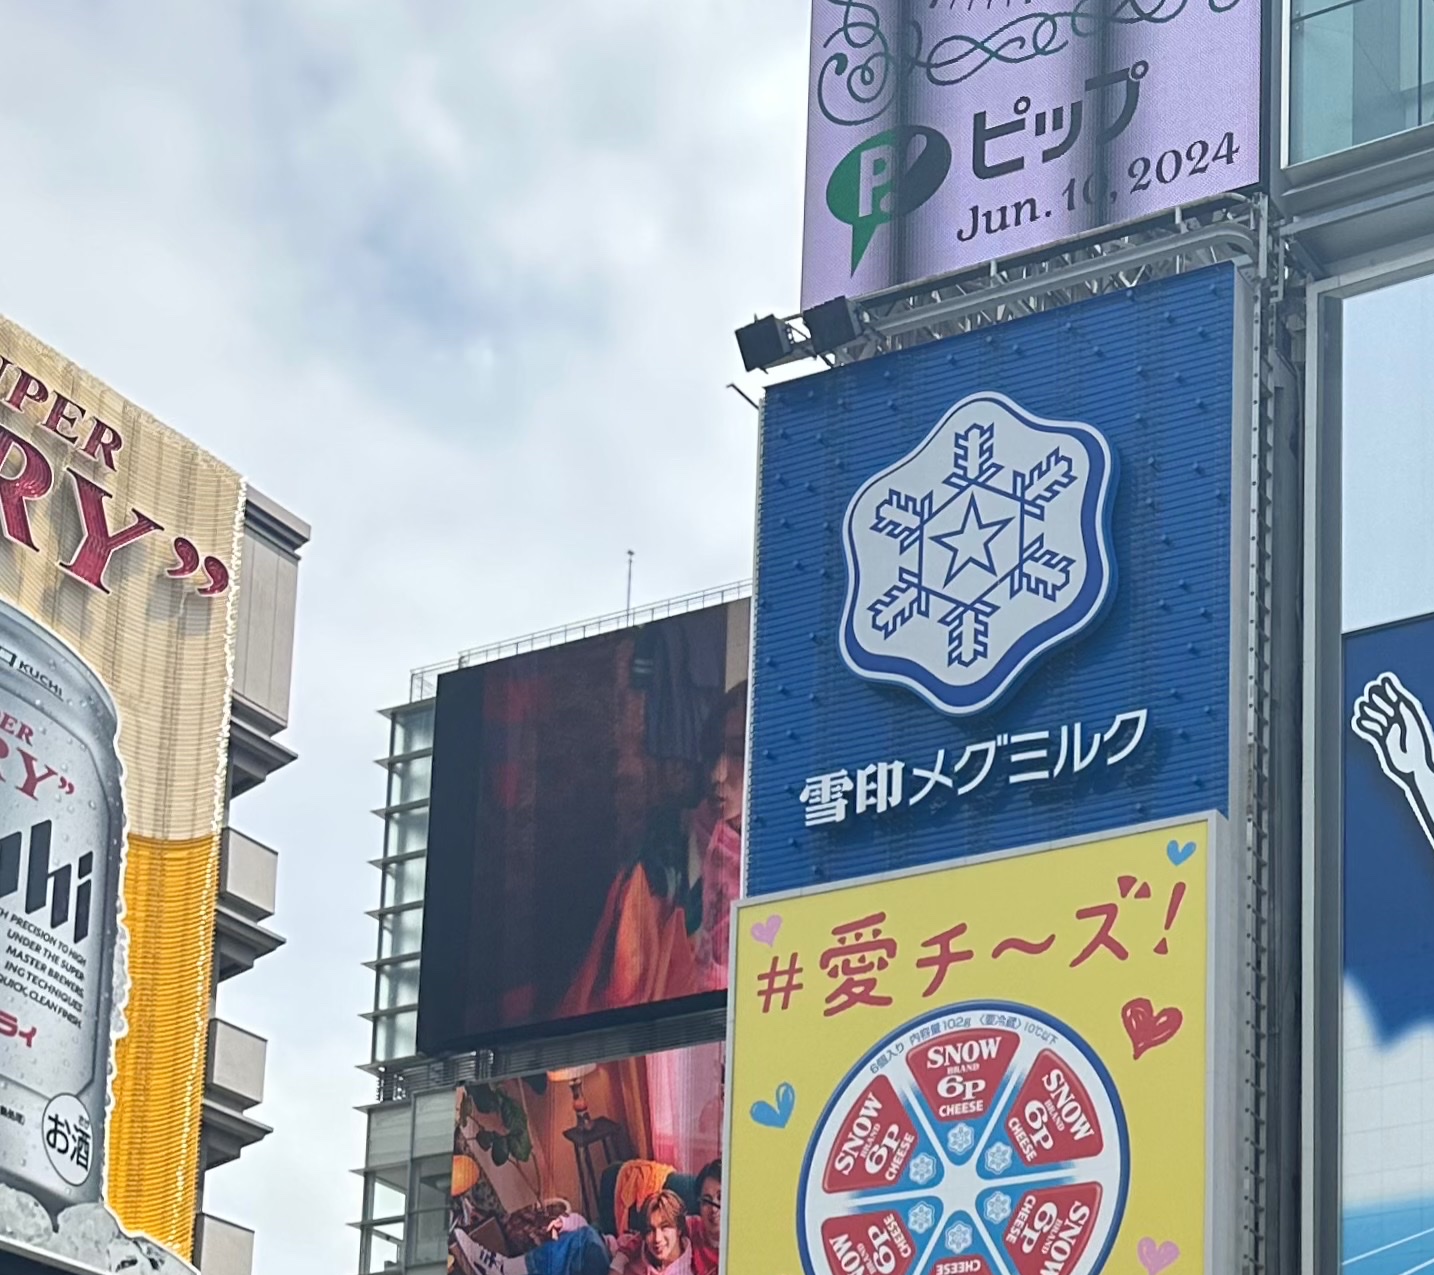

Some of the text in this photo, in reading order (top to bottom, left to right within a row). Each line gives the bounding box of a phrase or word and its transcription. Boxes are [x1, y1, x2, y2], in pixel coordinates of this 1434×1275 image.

[973, 60, 1149, 180] ピップ
[957, 195, 1052, 242] Jun.
[1128, 131, 1240, 194] 2024
[0, 354, 123, 472] PER
[18, 660, 63, 696] KUCHI
[0, 711, 34, 747] ER
[798, 709, 1149, 828] 雪印メグミルク
[7, 928, 42, 954] UNDER
[43, 947, 60, 965] THE
[10, 913, 57, 946] PRECISION
[58, 940, 69, 954] TO
[6, 945, 47, 973] MASTER
[4, 961, 83, 1013] ING TECHNIQUES
[29, 990, 58, 1013] CLEAN
[869, 1041, 905, 1075] 6個入り
[926, 1037, 1002, 1069] SNOW
[946, 1062, 981, 1076] BRAND
[938, 1099, 984, 1118] CHEESE
[1041, 1068, 1095, 1142] SNOW
[1044, 1098, 1066, 1133] BRAND
[46, 1114, 91, 1171] お酒
[834, 1092, 884, 1176] SNOW
[860, 1123, 881, 1159] BRAND
[1008, 1117, 1037, 1163] CHEESE
[885, 1132, 915, 1181] CHEESE
[883, 1213, 911, 1259] CHEESE
[1006, 1195, 1037, 1244] CHEESE
[1041, 1218, 1063, 1255] BRAND
[857, 1243, 877, 1275] BRAND
[936, 1259, 981, 1275] CHEESE
